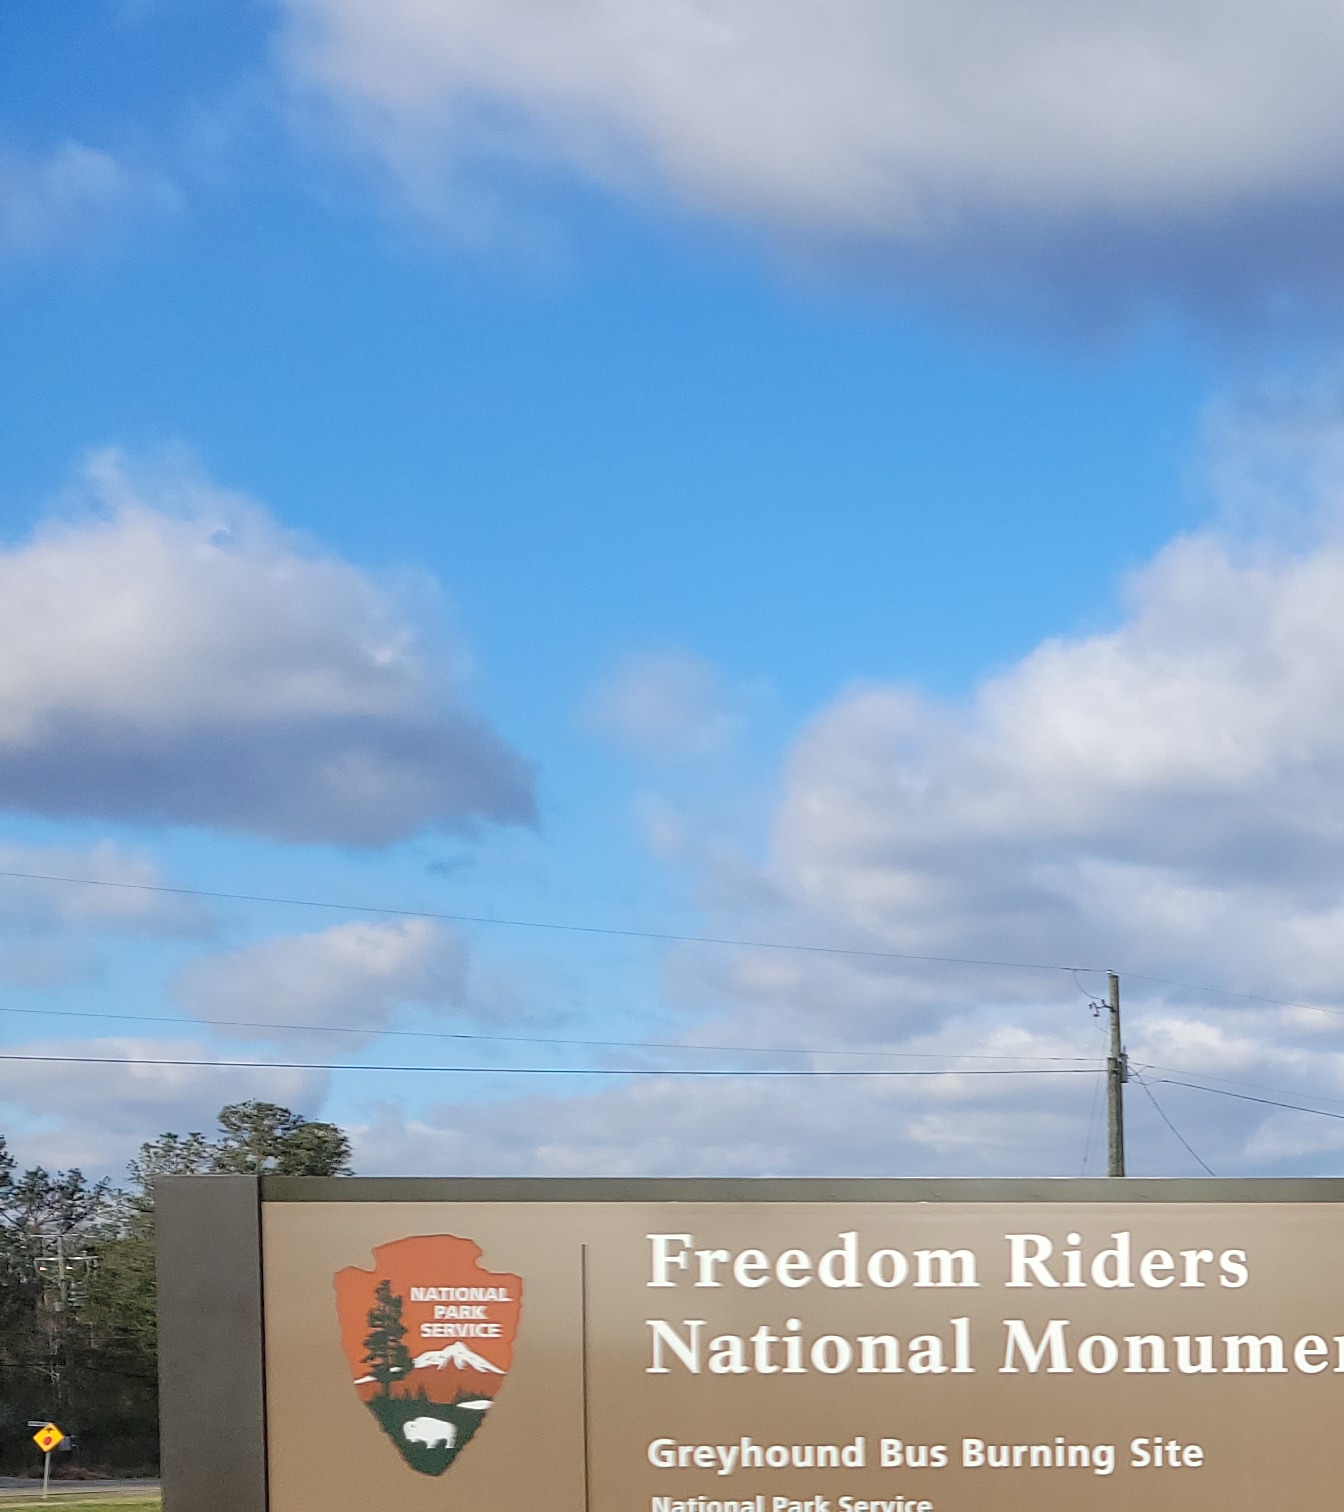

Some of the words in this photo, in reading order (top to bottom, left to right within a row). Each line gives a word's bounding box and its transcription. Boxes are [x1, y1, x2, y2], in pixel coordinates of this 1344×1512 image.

[646, 1231, 981, 1288] Freedom
[1004, 1231, 1249, 1288] Riders
[410, 1286, 513, 1301] NATIONAL
[434, 1305, 489, 1319] PARK
[420, 1323, 503, 1337] SERVICE
[645, 1317, 975, 1374] National
[648, 1437, 865, 1475] Greyhound
[881, 1438, 947, 1468] Bus
[962, 1437, 1115, 1475] Burning
[1130, 1436, 1204, 1468] Site
